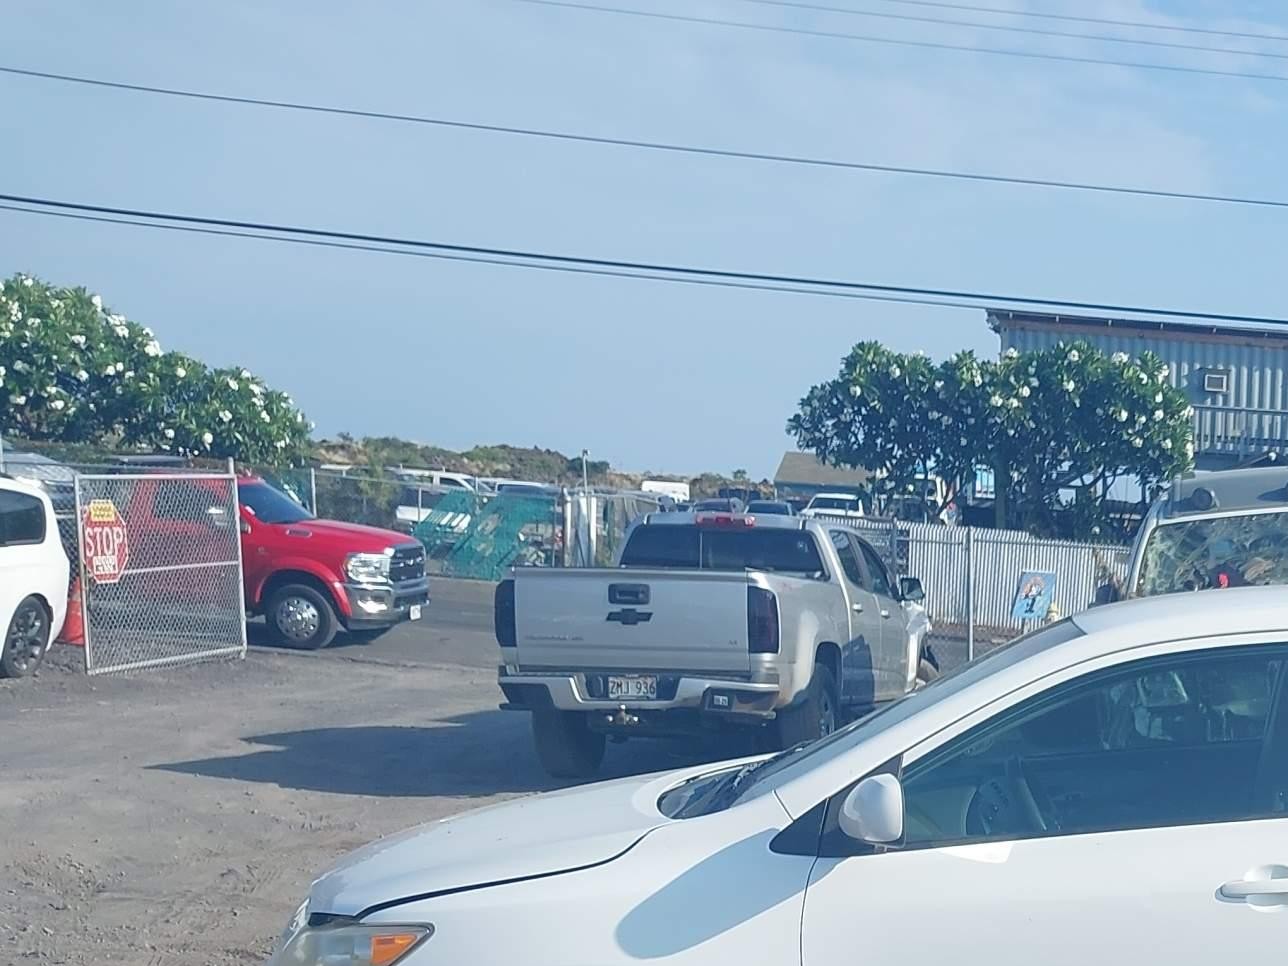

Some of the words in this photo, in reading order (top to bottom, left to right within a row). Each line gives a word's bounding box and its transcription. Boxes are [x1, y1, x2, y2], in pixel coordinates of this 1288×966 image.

[86, 526, 123, 558] STOP
[609, 680, 629, 694] ZMJ
[636, 680, 656, 694] 936
